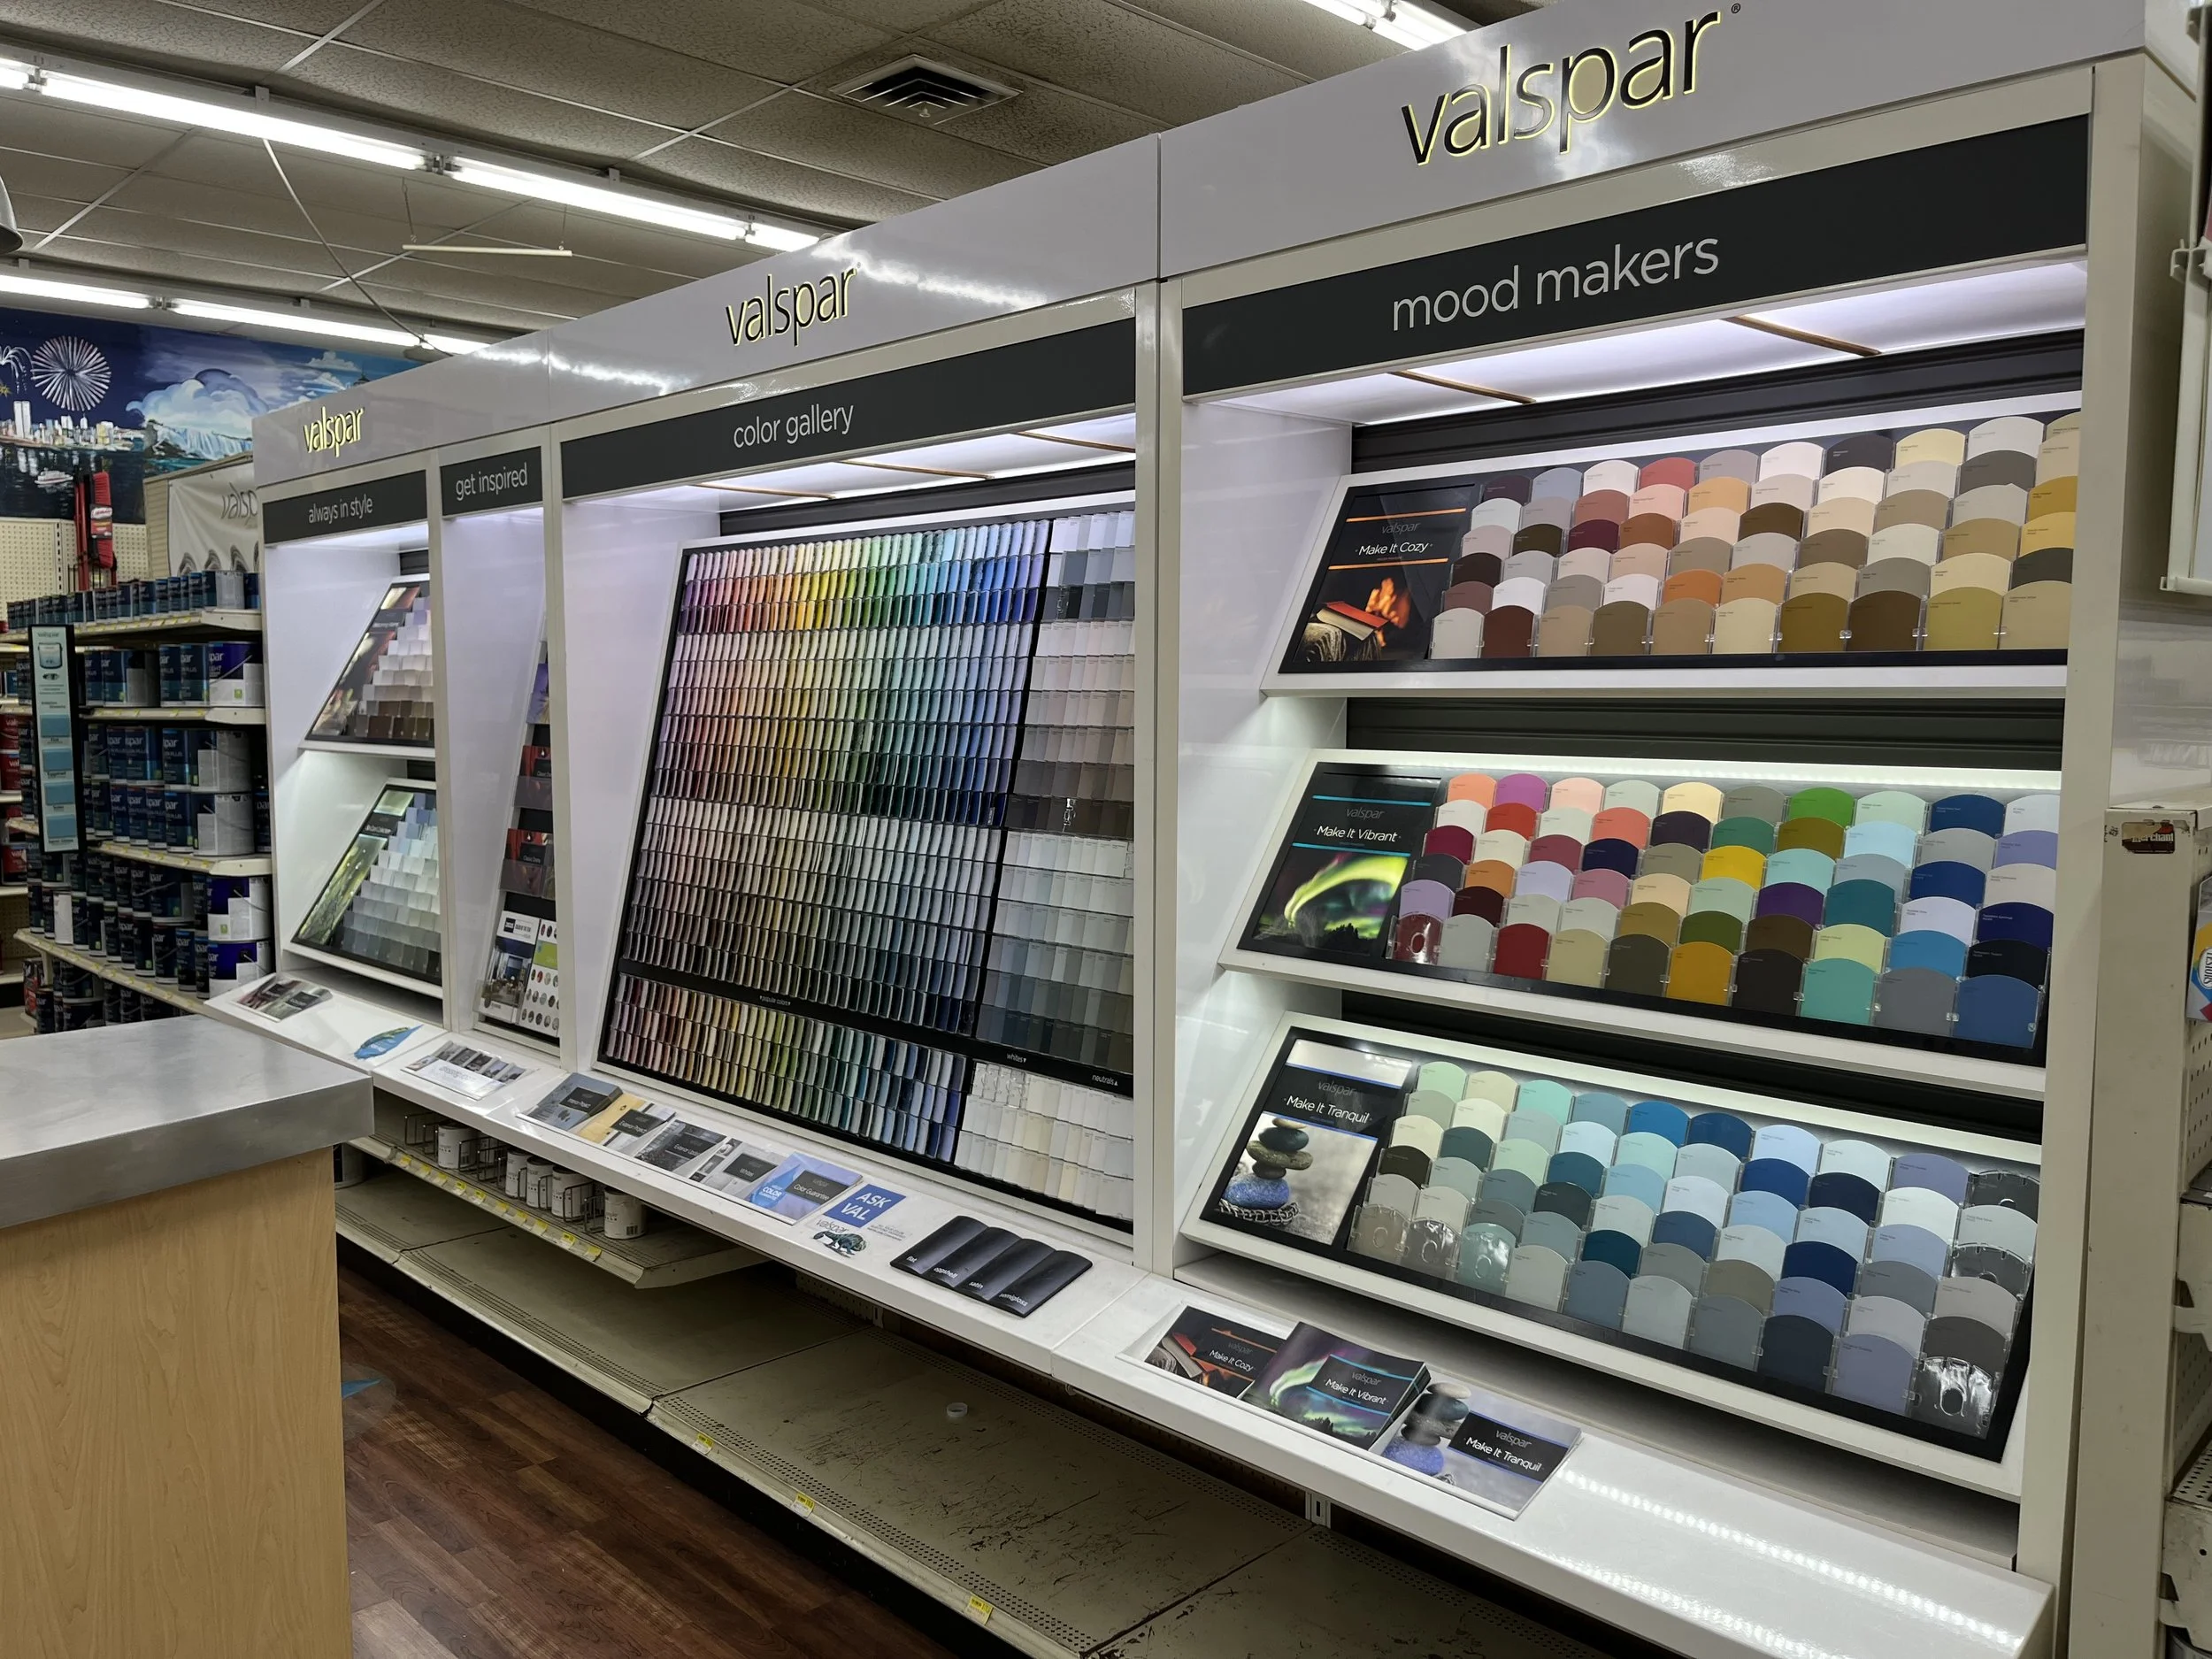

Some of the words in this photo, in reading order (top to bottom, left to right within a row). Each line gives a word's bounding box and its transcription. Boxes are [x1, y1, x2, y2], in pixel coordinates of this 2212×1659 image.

[1401, 9, 1721, 166] valspar
[1392, 266, 1519, 332] mood
[1536, 238, 1721, 306] makers
[726, 266, 857, 347] valspar
[303, 406, 365, 457] valspar
[733, 414, 780, 449] color
[786, 403, 854, 445] gallery
[456, 478, 476, 503] get
[479, 464, 528, 496] inspired
[308, 502, 338, 525] always
[340, 501, 349, 519] in
[350, 495, 373, 518] style
[1382, 522, 1421, 535] valspar
[1358, 544, 1388, 556] Make
[1389, 543, 1398, 554] It
[1400, 541, 1429, 553] Cozy
[1346, 807, 1385, 820] valspar
[1316, 826, 1346, 838] Make
[1347, 828, 1356, 839] It
[1358, 828, 1398, 842] Vibrant
[1006, 1053, 1023, 1063] whites
[1092, 1073, 1115, 1087] neutrals
[1317, 1079, 1357, 1096] valspar
[1286, 1095, 1315, 1111] Make
[1317, 1102, 1326, 1114] It
[1327, 1104, 1370, 1124] Tranquil
[794, 1184, 807, 1194] Color
[806, 1187, 830, 1201] Guarantee
[856, 1192, 892, 1209] ASK
[841, 1202, 871, 1221] VAL
[816, 1219, 849, 1233] valspar
[933, 1267, 958, 1279] eggshell
[999, 1293, 1029, 1308] semigloss
[1209, 1349, 1229, 1363] Make
[1228, 1356, 1235, 1365] It
[1234, 1359, 1254, 1372] Cozy
[1351, 1372, 1381, 1386] valspar
[1325, 1379, 1348, 1394] Make
[1348, 1386, 1357, 1397] It
[1357, 1389, 1387, 1405] Vibrant
[1495, 1430, 1532, 1448] valspar
[1465, 1437, 1493, 1454] Make
[1494, 1448, 1502, 1458] It
[1503, 1450, 1542, 1471] Tranquil
